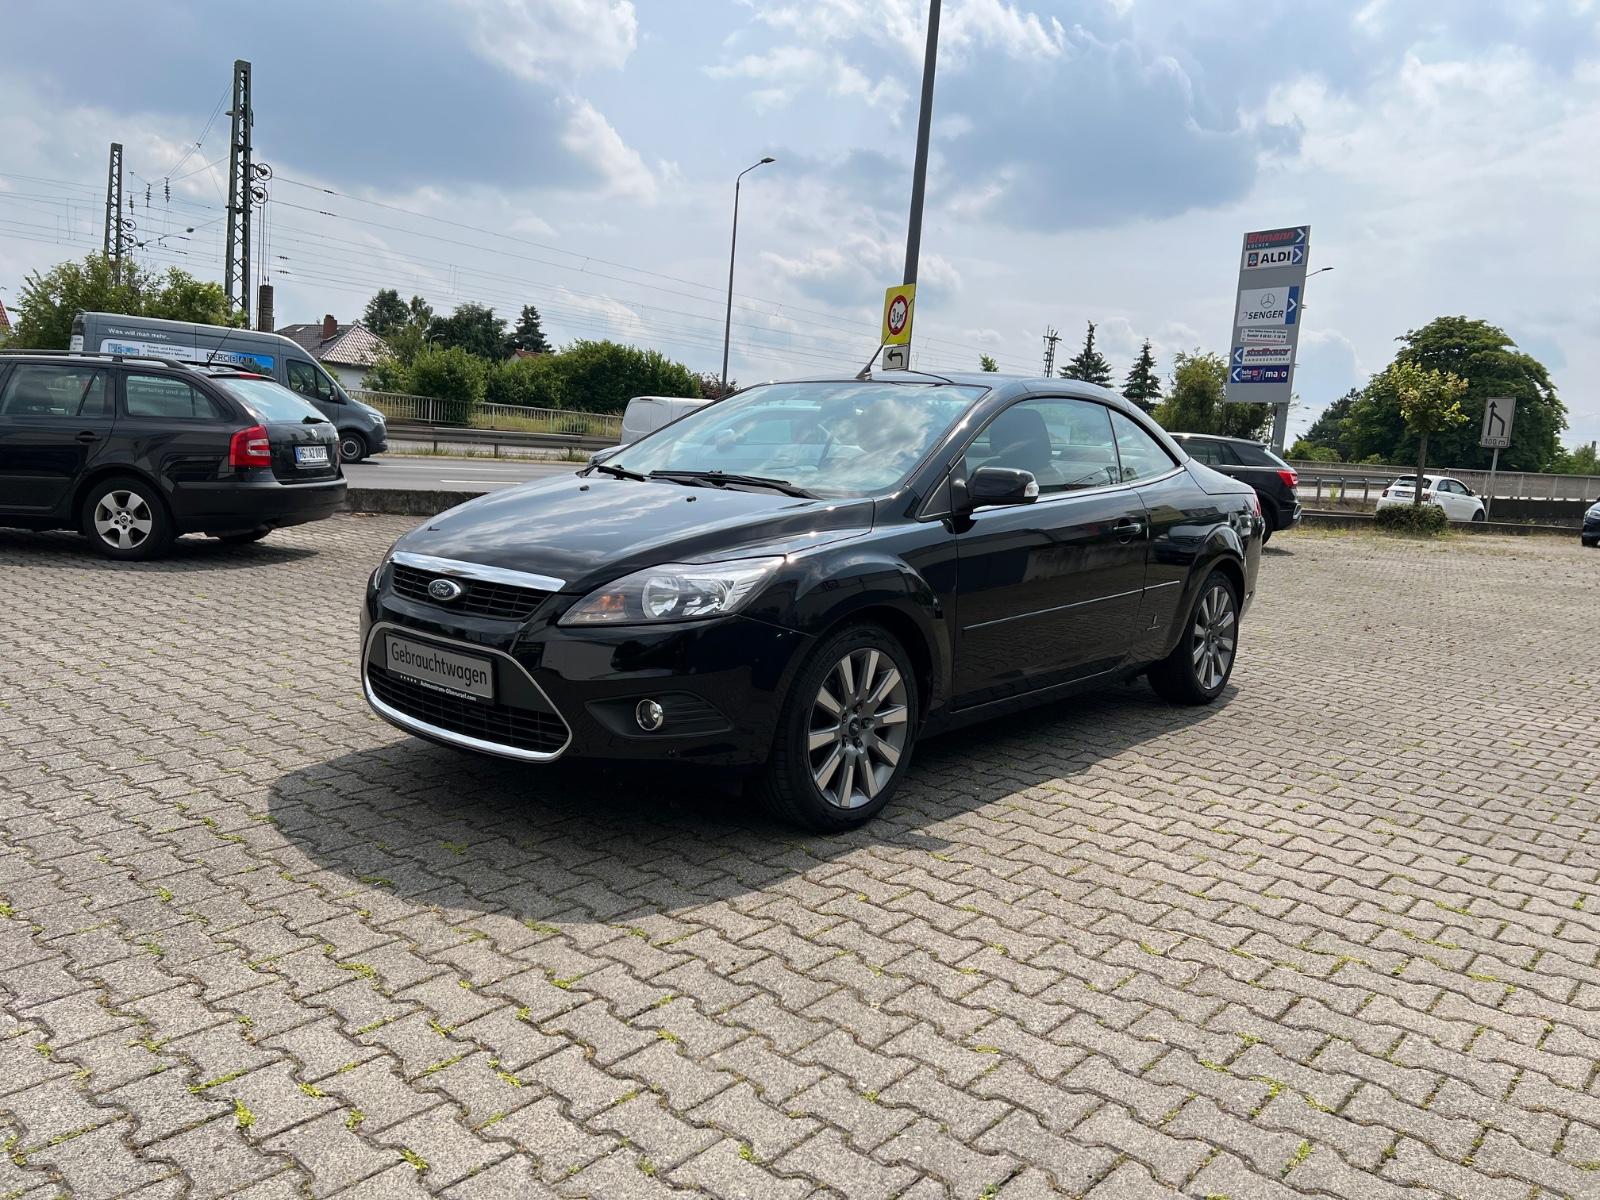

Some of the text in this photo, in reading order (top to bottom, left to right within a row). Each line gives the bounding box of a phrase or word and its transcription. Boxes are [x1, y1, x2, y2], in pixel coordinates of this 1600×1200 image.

[1260, 251, 1291, 263] ALDI
[1248, 310, 1284, 320] SENGER
[432, 583, 451, 596] Ford
[391, 642, 487, 687] Gebrauchtwagen
